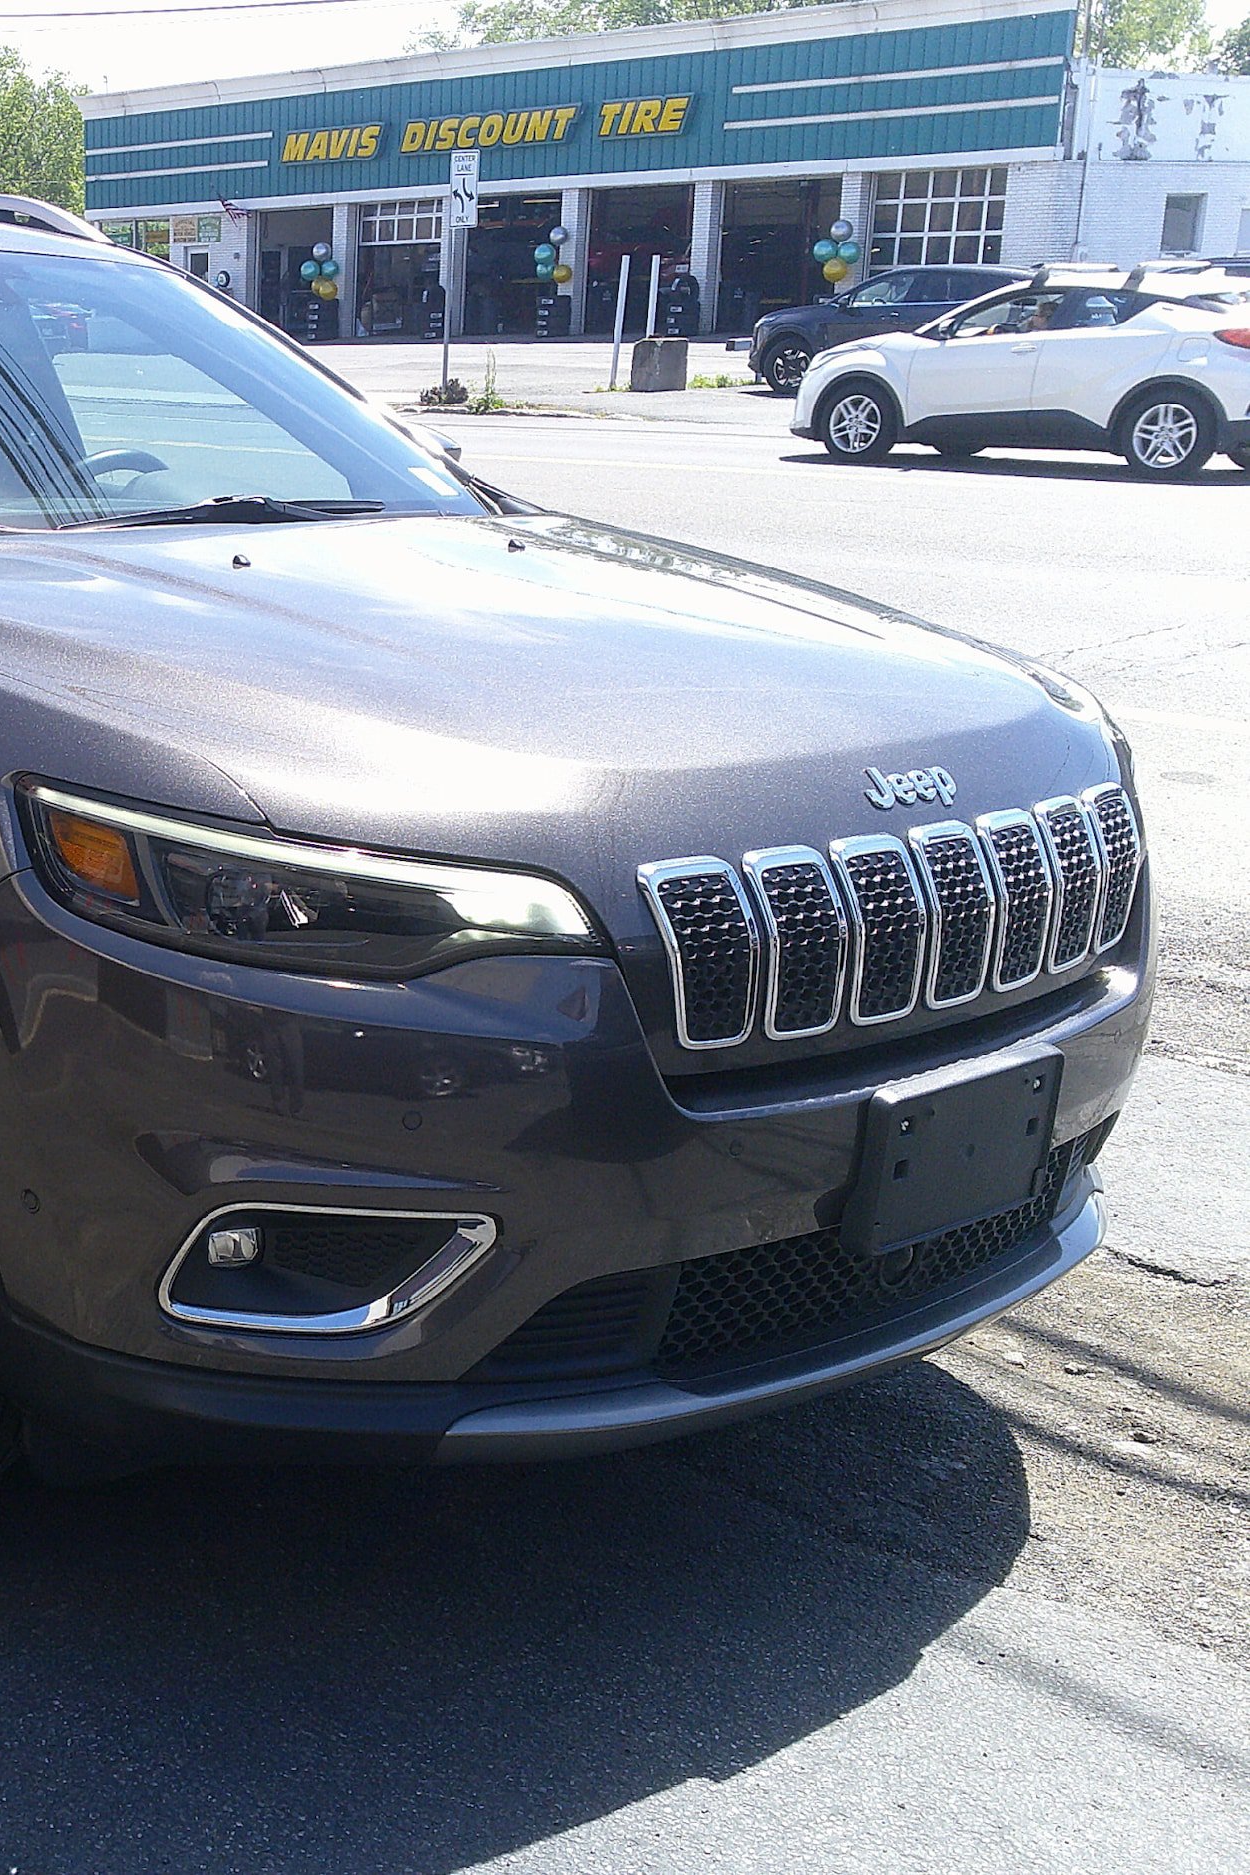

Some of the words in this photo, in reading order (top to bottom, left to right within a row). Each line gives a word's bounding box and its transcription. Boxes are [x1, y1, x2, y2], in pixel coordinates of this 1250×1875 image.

[281, 124, 382, 163] MAVIS
[400, 106, 578, 154] DISCOUNT
[599, 96, 691, 136] TIRE
[456, 164, 472, 172] LANE
[455, 215, 470, 223] ONLY
[864, 766, 956, 809] Jeep
